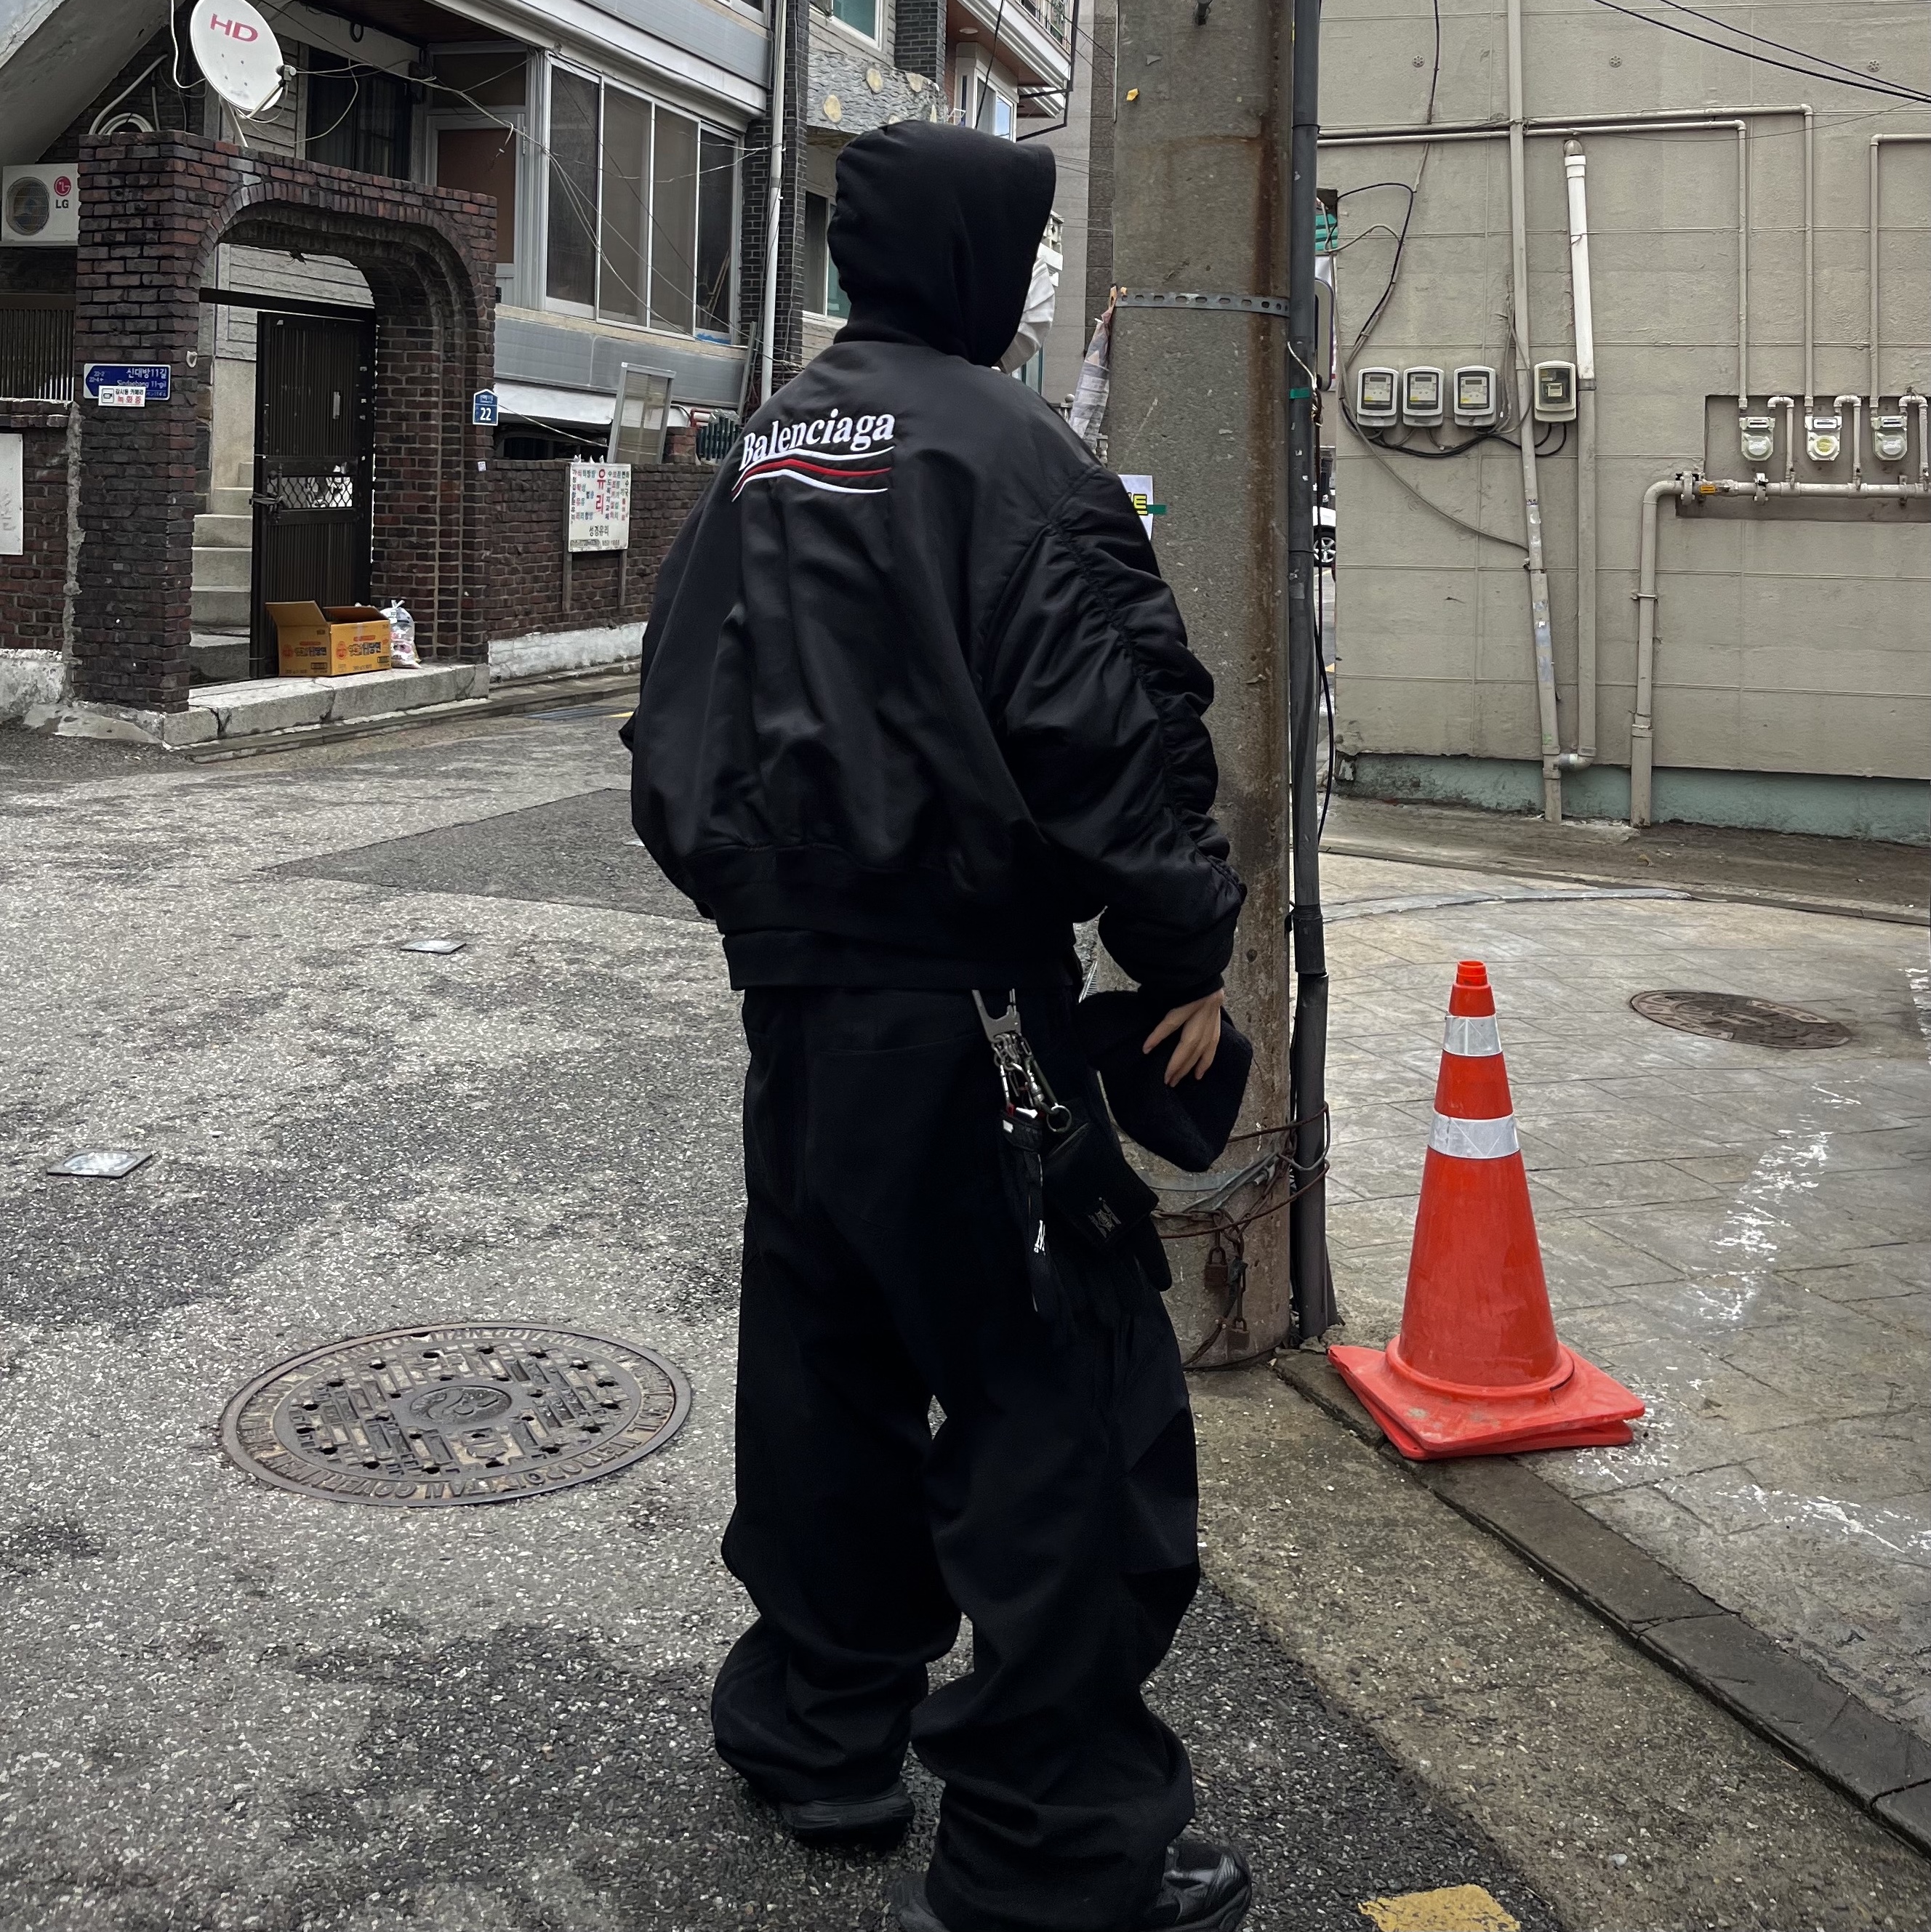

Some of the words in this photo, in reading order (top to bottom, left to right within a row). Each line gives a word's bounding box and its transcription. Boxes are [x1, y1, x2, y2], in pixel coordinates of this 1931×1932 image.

[210, 13, 259, 42] HD
[55, 198, 70, 209] LG
[126, 367, 167, 379] 신대방11길
[150, 380, 167, 389] 11-gil
[480, 407, 491, 421] 22
[738, 408, 896, 472] Balenciaga
[595, 468, 606, 515] 유리
[419, 1435, 645, 1497] METROPOLITAN
